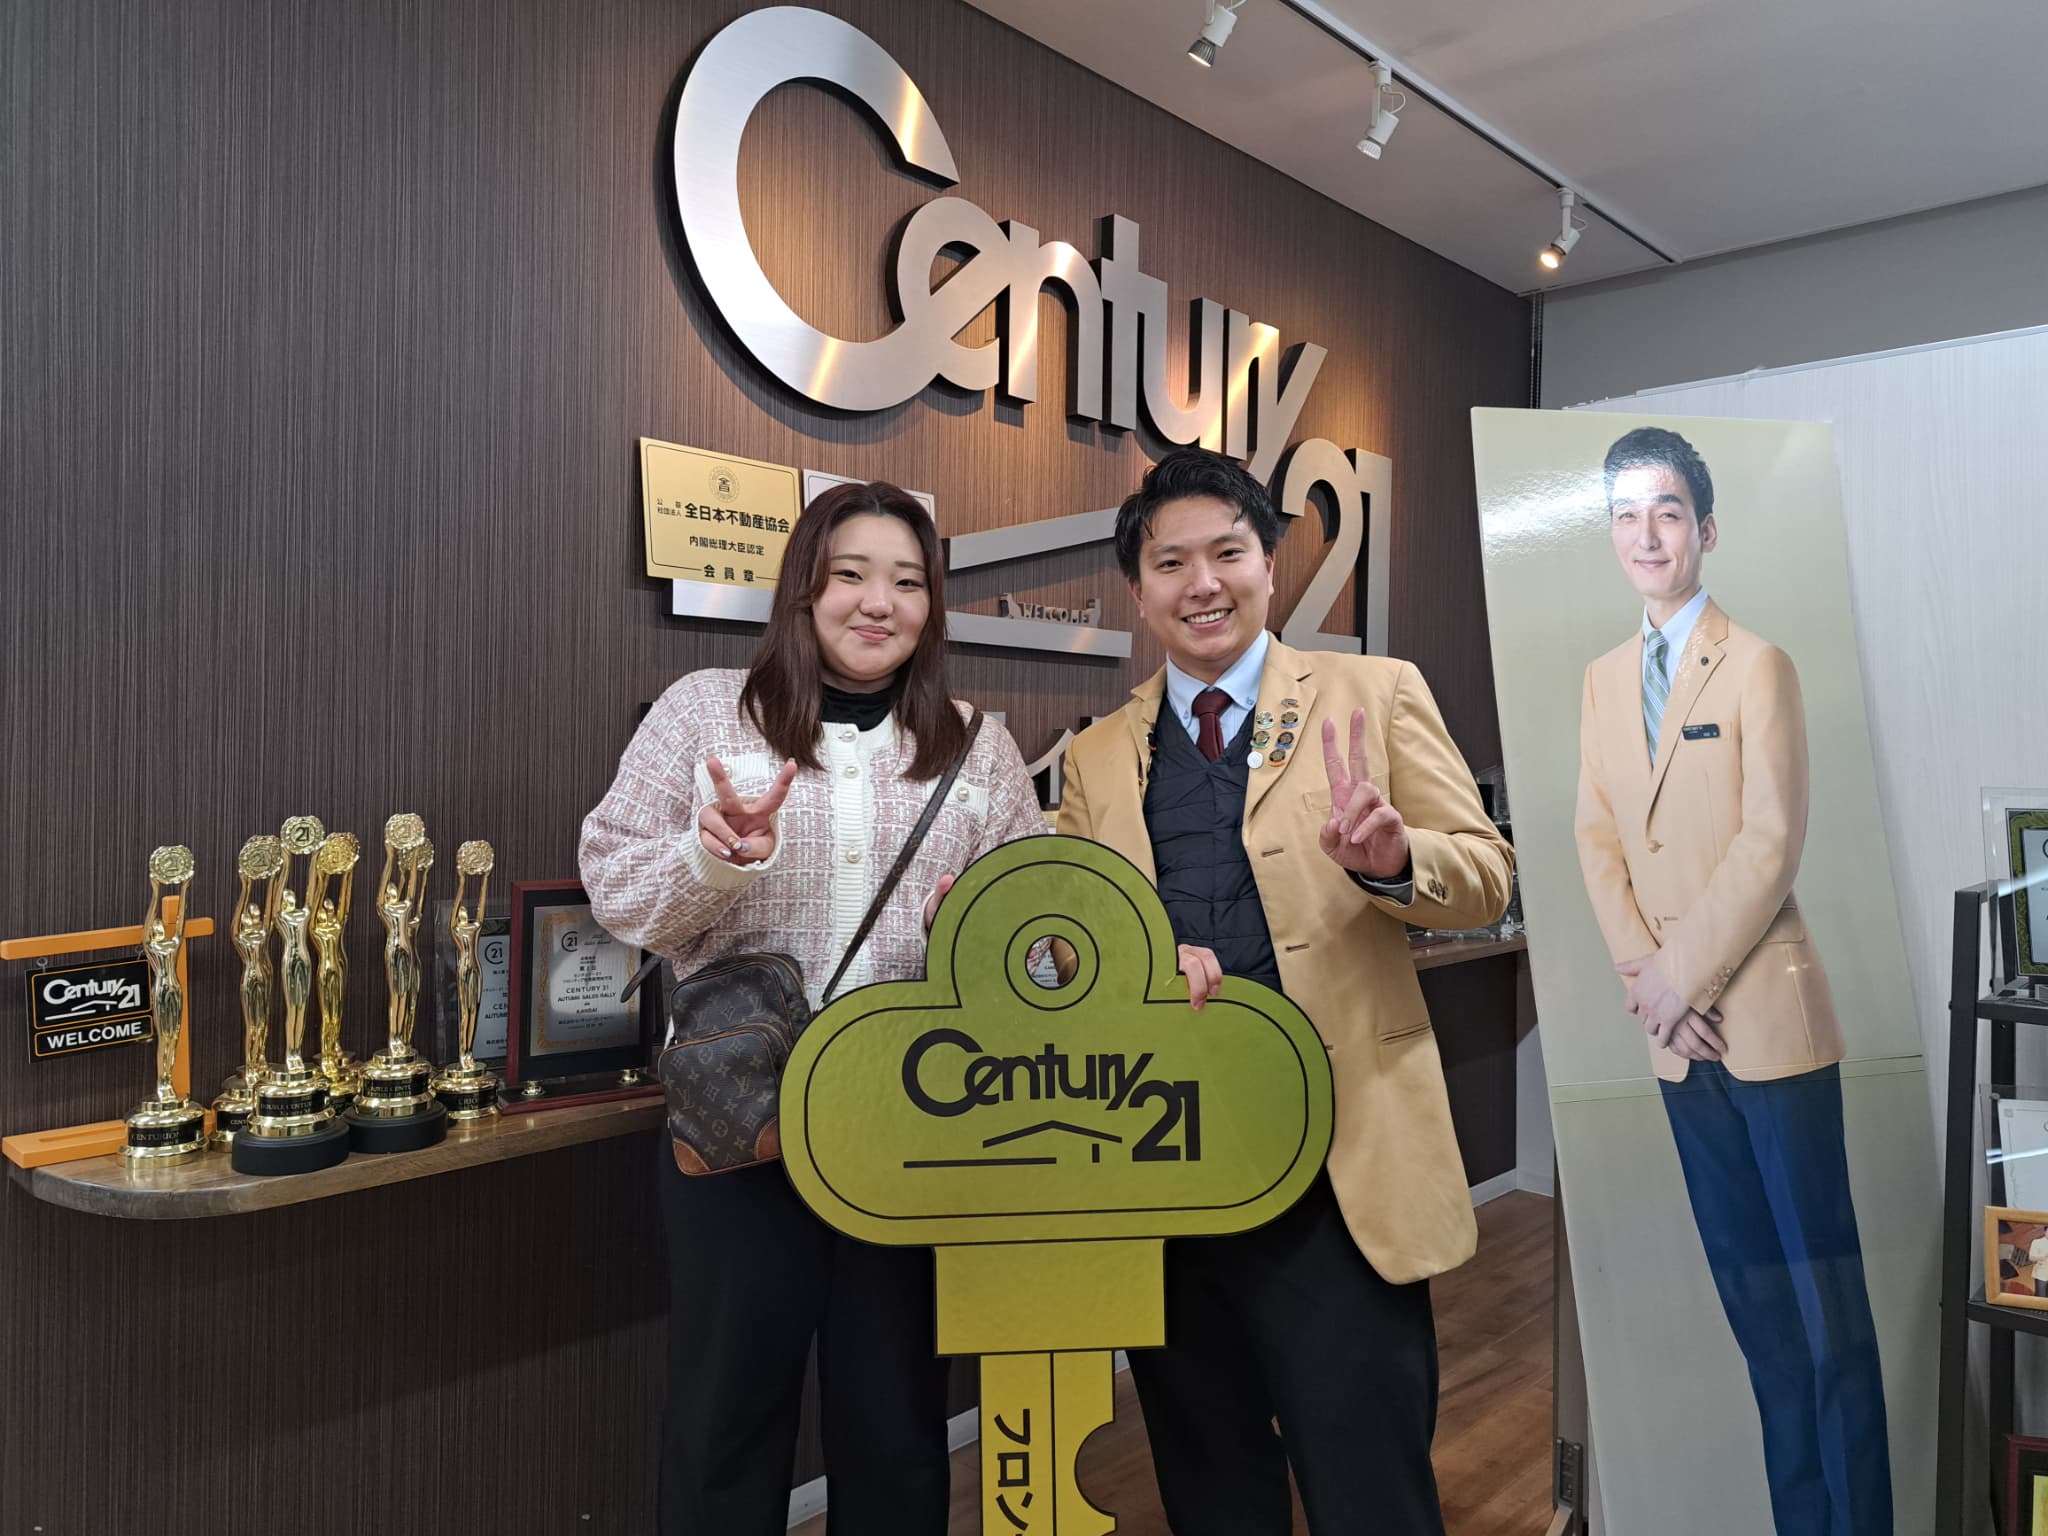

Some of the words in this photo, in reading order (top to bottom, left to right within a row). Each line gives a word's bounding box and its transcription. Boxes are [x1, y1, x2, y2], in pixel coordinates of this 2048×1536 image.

[672, 4, 1328, 488] Century
[1276, 437, 1393, 654] 21
[684, 502, 791, 534] 全日本不動産協会
[688, 535, 766, 556] 内閣総理大臣認定
[1017, 602, 1090, 625] WELCOME
[42, 978, 127, 1005] Century
[117, 983, 141, 1009] 21
[566, 985, 600, 994] CENTURY
[46, 1022, 143, 1049] WELCOME
[901, 1027, 1155, 1117] Century
[1128, 1079, 1202, 1163] 21
[993, 1408, 1033, 1536] フロン
